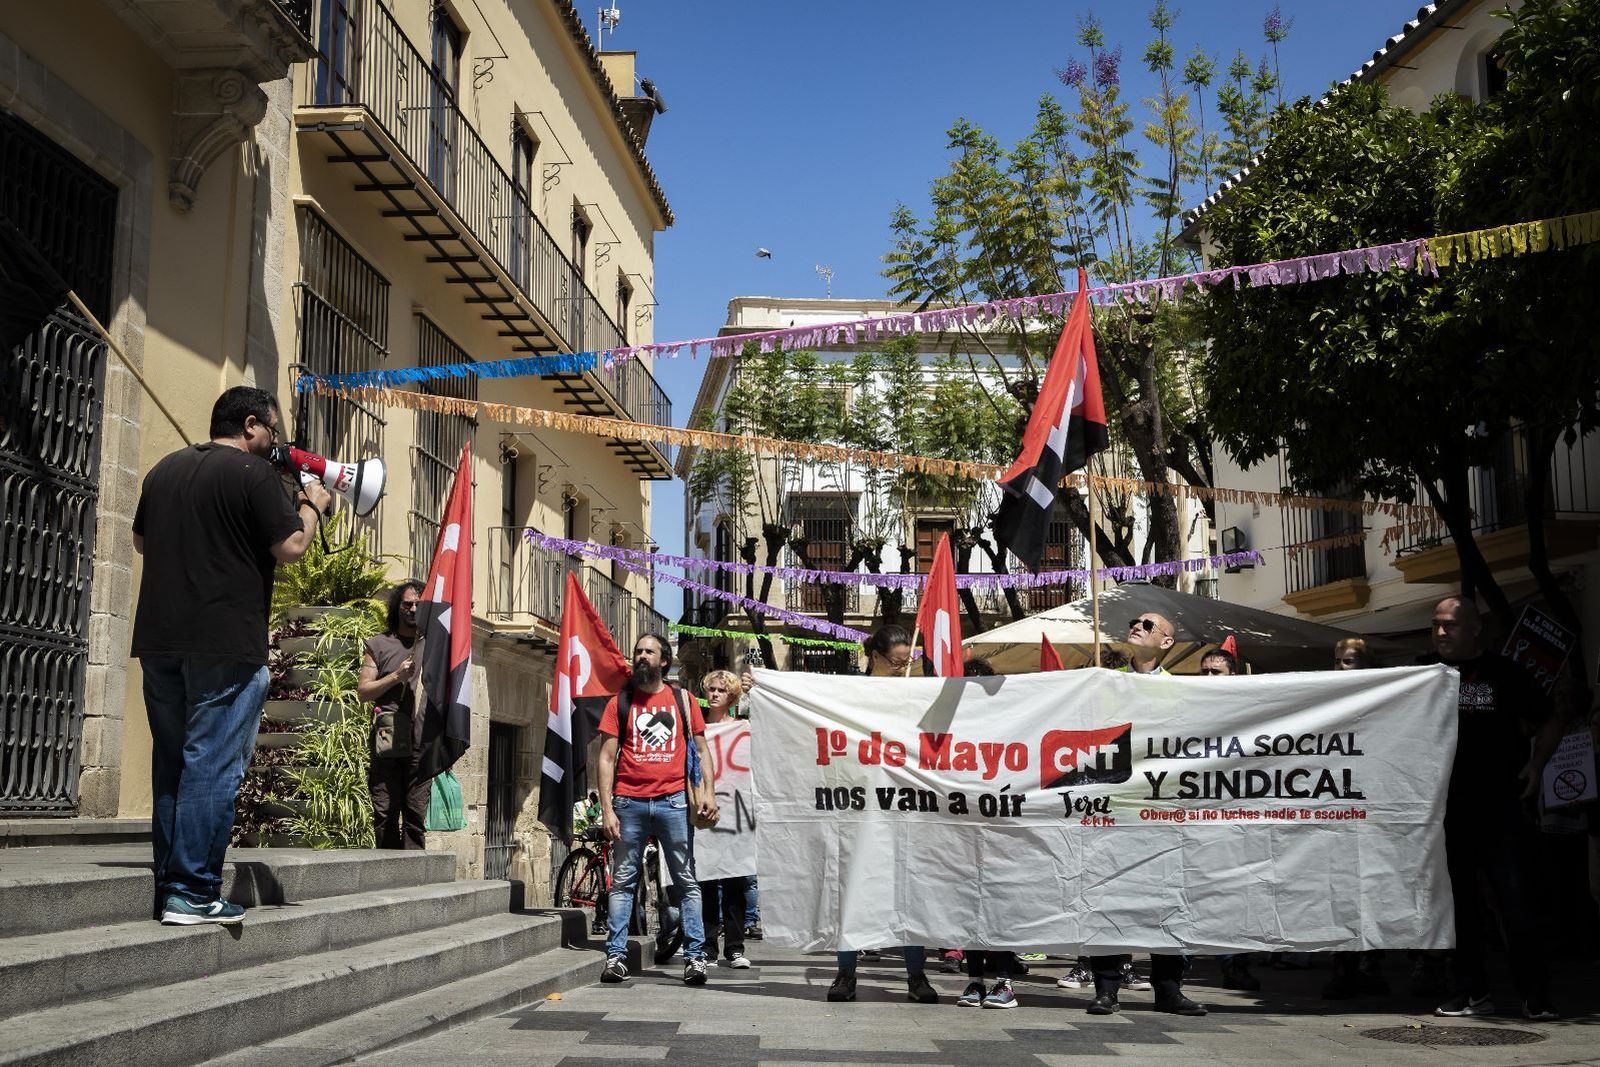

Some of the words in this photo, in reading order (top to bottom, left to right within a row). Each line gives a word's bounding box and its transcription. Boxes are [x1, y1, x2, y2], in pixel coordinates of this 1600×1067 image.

[857, 731, 906, 768] de
[918, 732, 1028, 780] Mayo
[1053, 743, 1119, 773] CNT
[1144, 736, 1245, 759] LUCHA
[1253, 732, 1364, 756] SOCIAL
[1143, 771, 1169, 800] Y
[1177, 768, 1367, 800] SINDICAL
[815, 787, 866, 811] nos
[875, 787, 940, 813] van
[948, 791, 969, 815] a
[978, 783, 1026, 818] oír
[1057, 790, 1113, 818] Jerez
[1140, 808, 1186, 823] Obrer@
[1188, 808, 1200, 821] si
[1202, 809, 1218, 821] no
[1264, 807, 1297, 820] nadie
[1300, 808, 1312, 820] te
[1314, 807, 1367, 820] escucha
